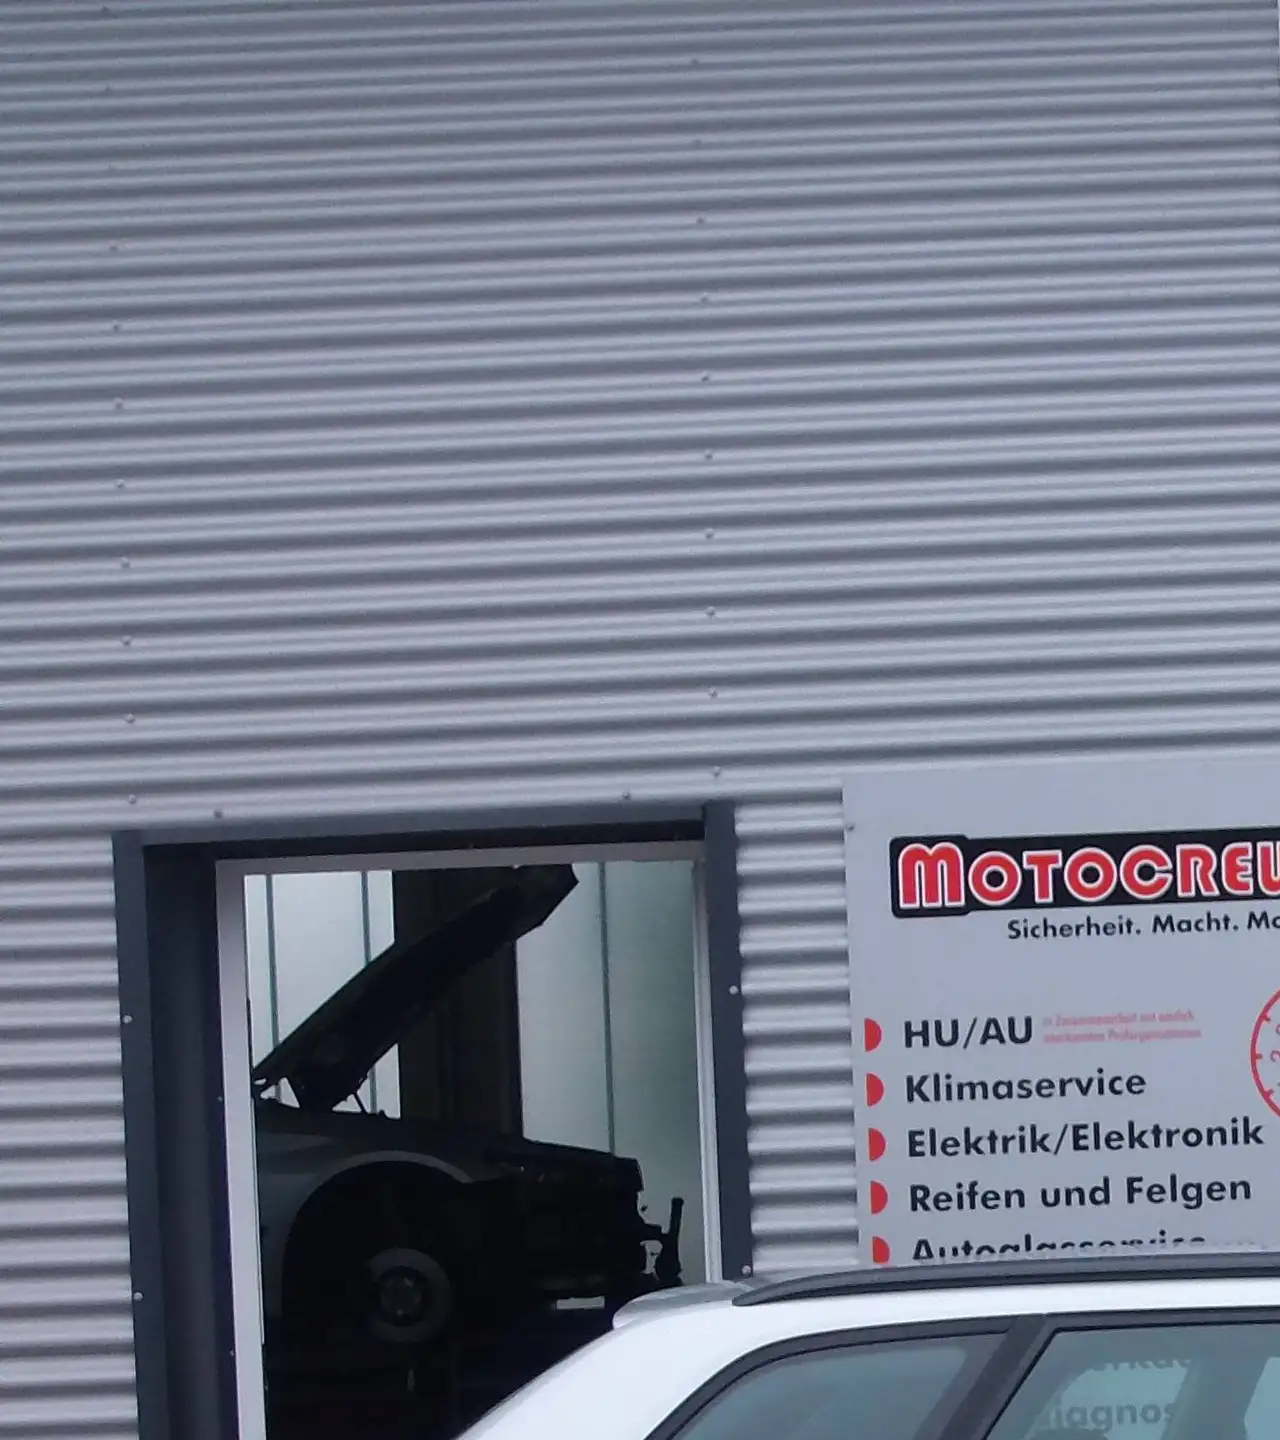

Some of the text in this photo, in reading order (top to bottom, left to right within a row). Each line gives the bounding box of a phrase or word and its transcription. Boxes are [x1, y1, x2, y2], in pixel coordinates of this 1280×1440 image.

[1007, 914, 1142, 940] Sicherheit.
[1152, 910, 1239, 935] Macht.
[903, 1015, 1033, 1050] HU/AU
[906, 1067, 1147, 1103] Klimaservice
[907, 1115, 1264, 1158] Elektrik/Elektronik
[909, 1171, 1252, 1213] Reifen und Felgen
